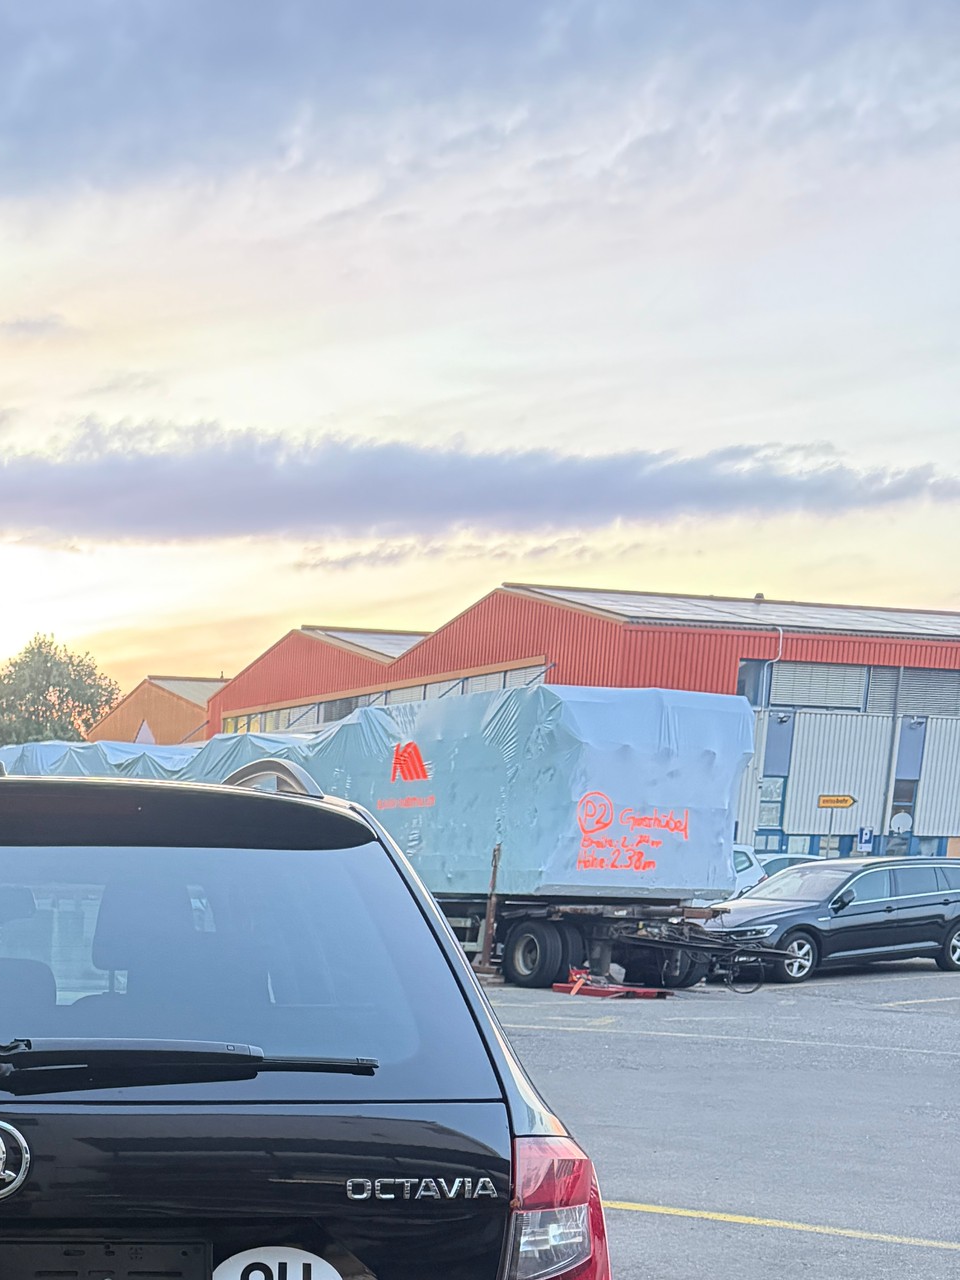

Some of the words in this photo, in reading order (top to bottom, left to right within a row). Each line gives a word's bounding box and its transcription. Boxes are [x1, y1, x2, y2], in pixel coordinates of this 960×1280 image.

[583, 800, 610, 827] P2
[862, 830, 870, 844] P
[346, 1178, 498, 1200] OCTAVIA
